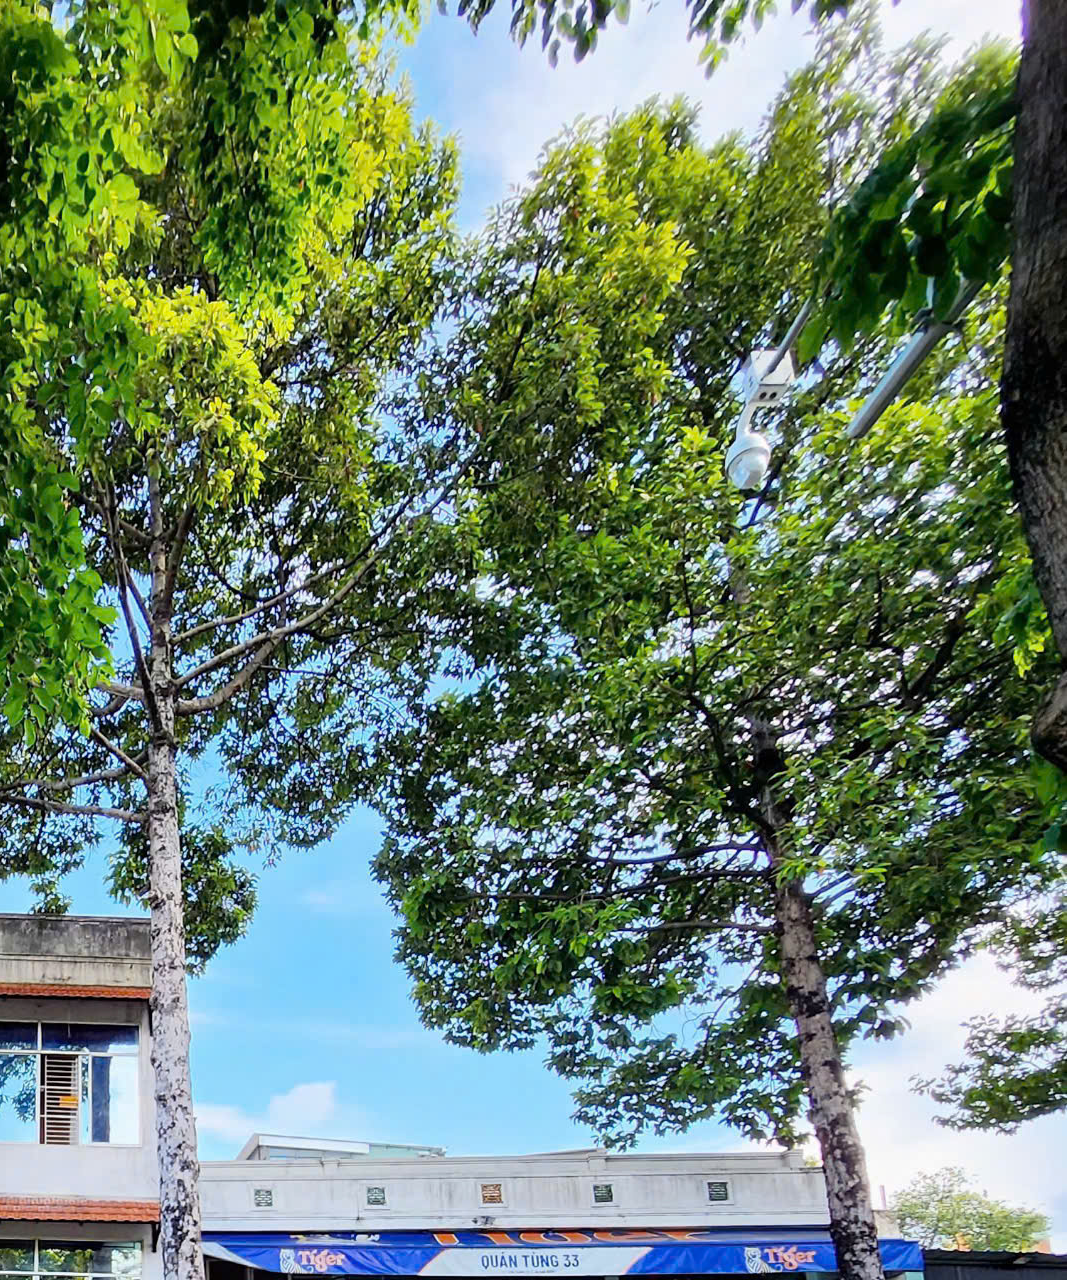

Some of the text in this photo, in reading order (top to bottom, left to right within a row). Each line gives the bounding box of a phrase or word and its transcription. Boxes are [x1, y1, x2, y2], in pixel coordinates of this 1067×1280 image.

[298, 1251, 345, 1270] Tiger
[481, 1252, 580, 1269] QUÁN TÙNG 33
[764, 1245, 817, 1269] Tiger
